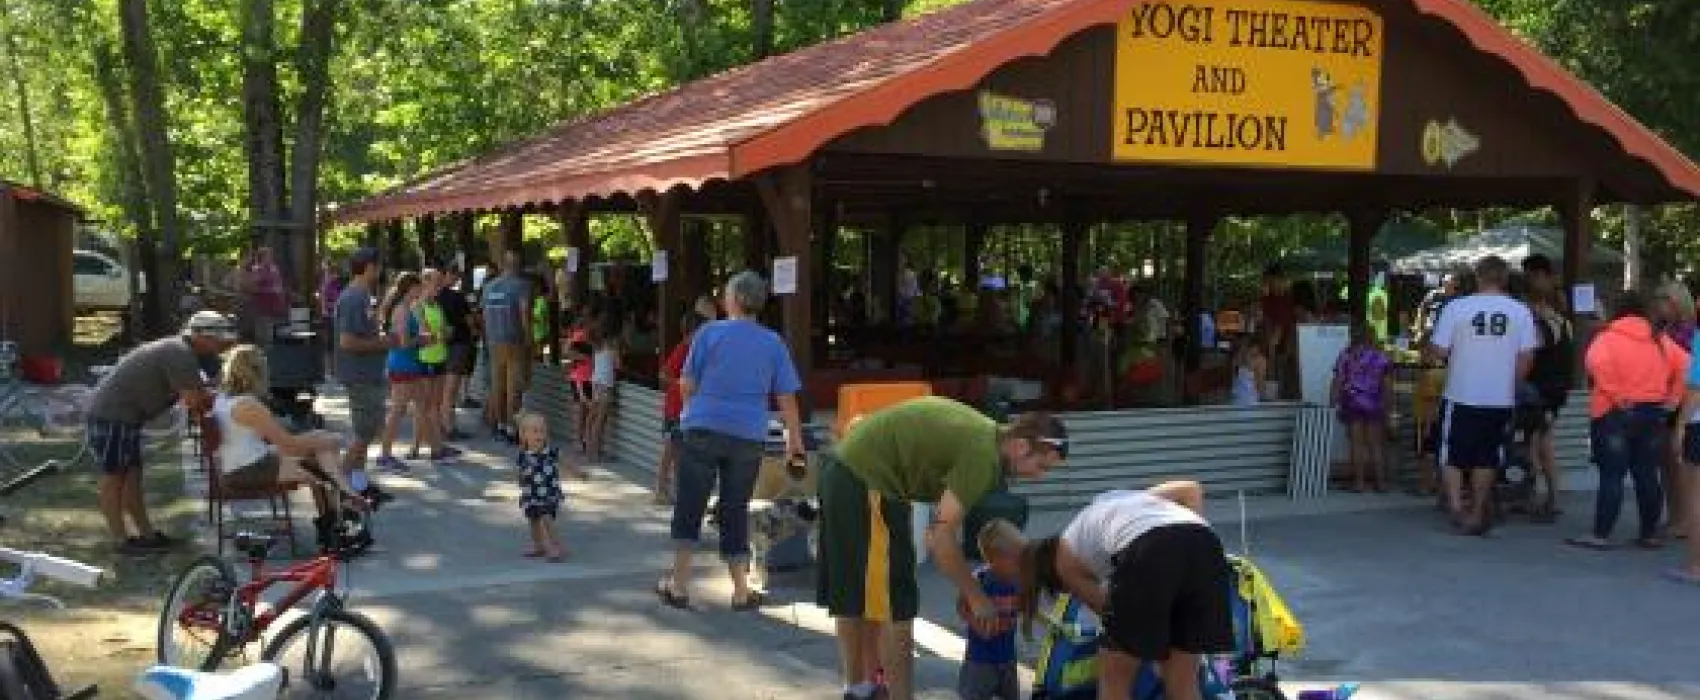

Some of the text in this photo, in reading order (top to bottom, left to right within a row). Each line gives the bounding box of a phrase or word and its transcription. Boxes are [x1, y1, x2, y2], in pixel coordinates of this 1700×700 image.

[1132, 2, 1373, 56] YOGI THEATER
[1192, 65, 1246, 95] AND
[1124, 107, 1288, 151] PAVILION
[1471, 310, 1507, 336] 48
